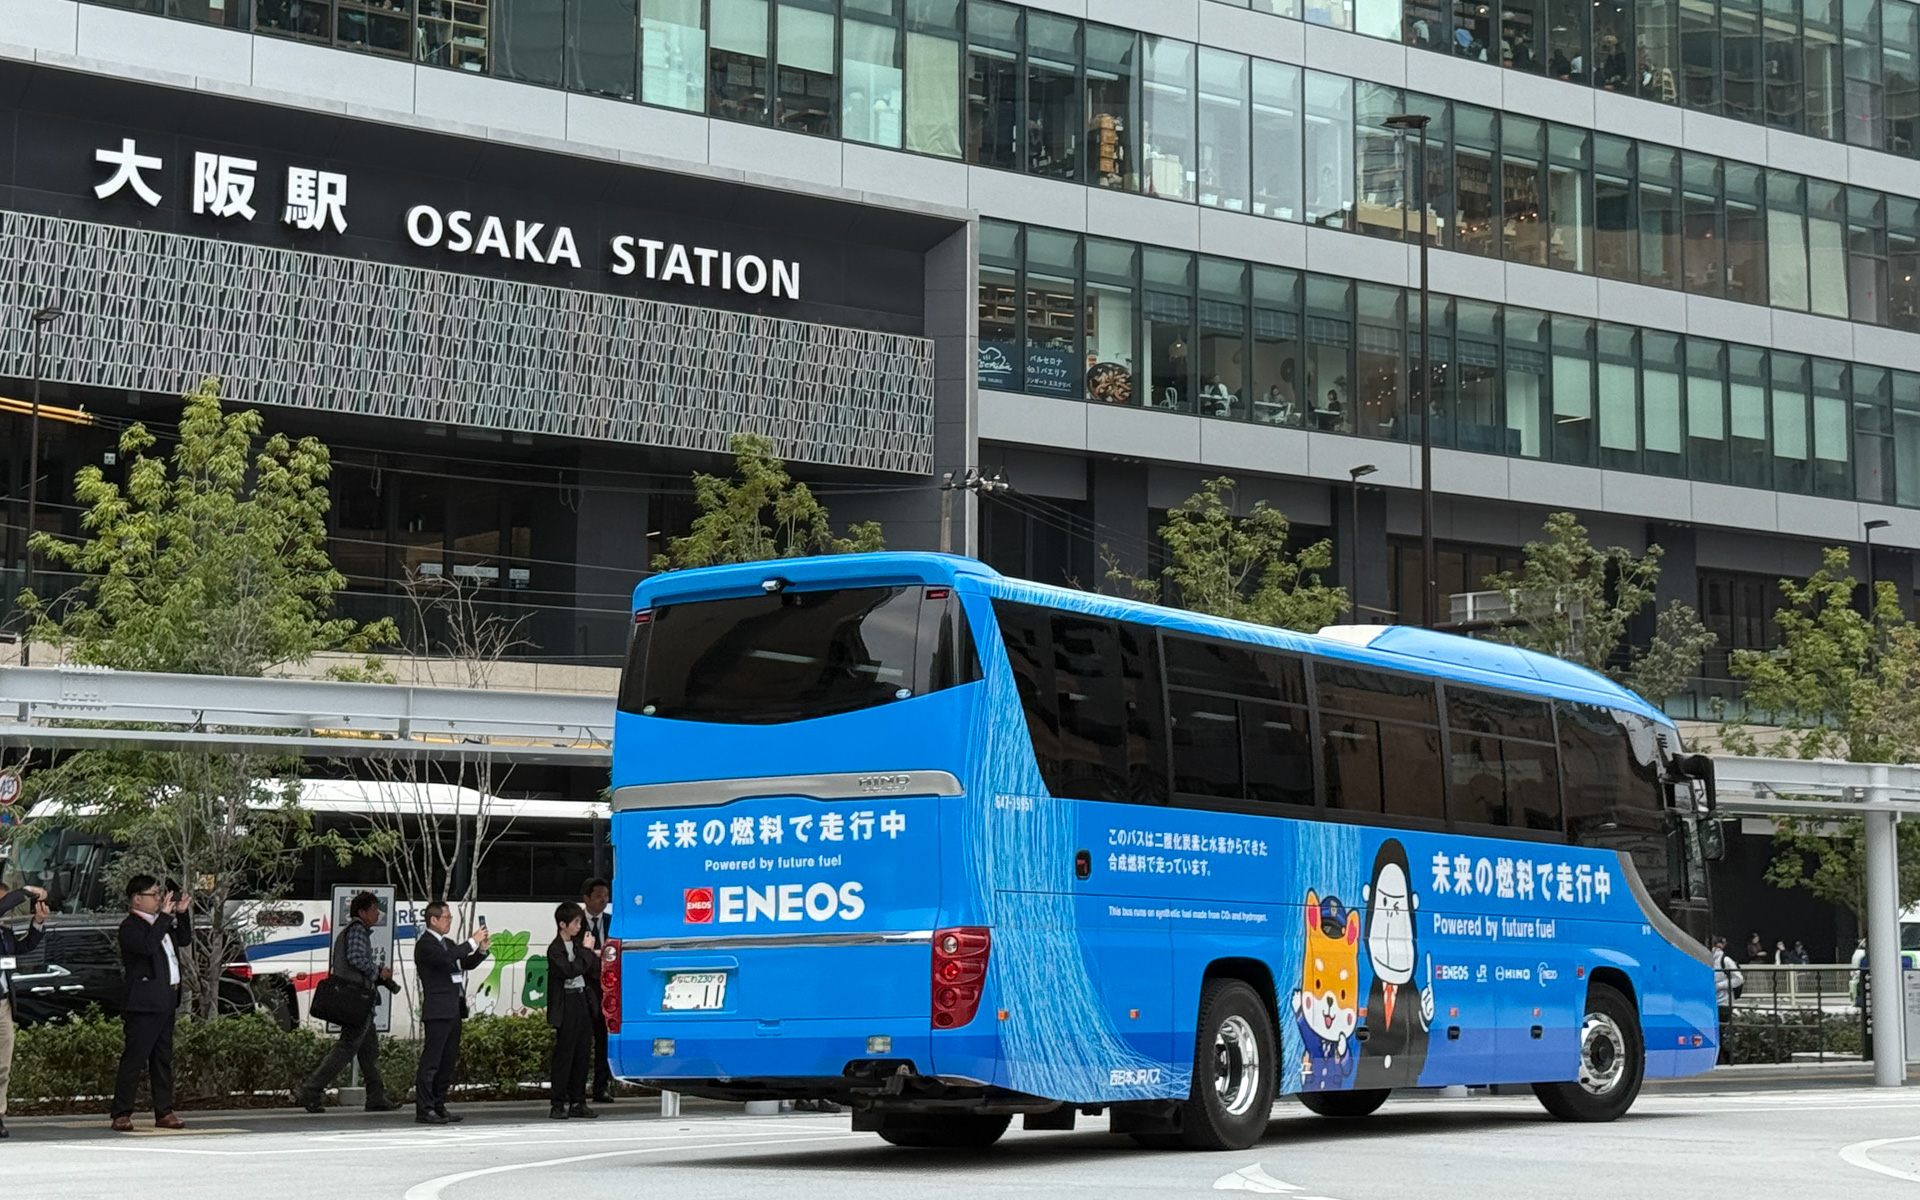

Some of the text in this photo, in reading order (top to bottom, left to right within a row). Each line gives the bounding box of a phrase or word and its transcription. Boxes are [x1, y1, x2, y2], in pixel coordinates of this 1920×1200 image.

[94, 138, 348, 234] 大阪駅
[406, 204, 801, 300] OSAKA STATION
[1029, 354, 1063, 367] バルセロナ
[647, 810, 906, 850] 未来の燃料で走行中
[1108, 829, 1268, 856] このバスは二酸化炭素と水素からできた
[705, 854, 842, 871] Powered by future fuel
[1108, 852, 1211, 877] 合成燃料で走っています。
[1432, 851, 1611, 905] 未来の燃料で走行中
[687, 902, 712, 910] ENEOS
[719, 881, 866, 923] ENEOS
[1108, 905, 1121, 916] This
[1434, 913, 1555, 941] Powered by future fuel
[1442, 965, 1469, 980] ENEOS
[1505, 969, 1530, 980] HINO
[1110, 1068, 1160, 1086] 西日本JRバス
